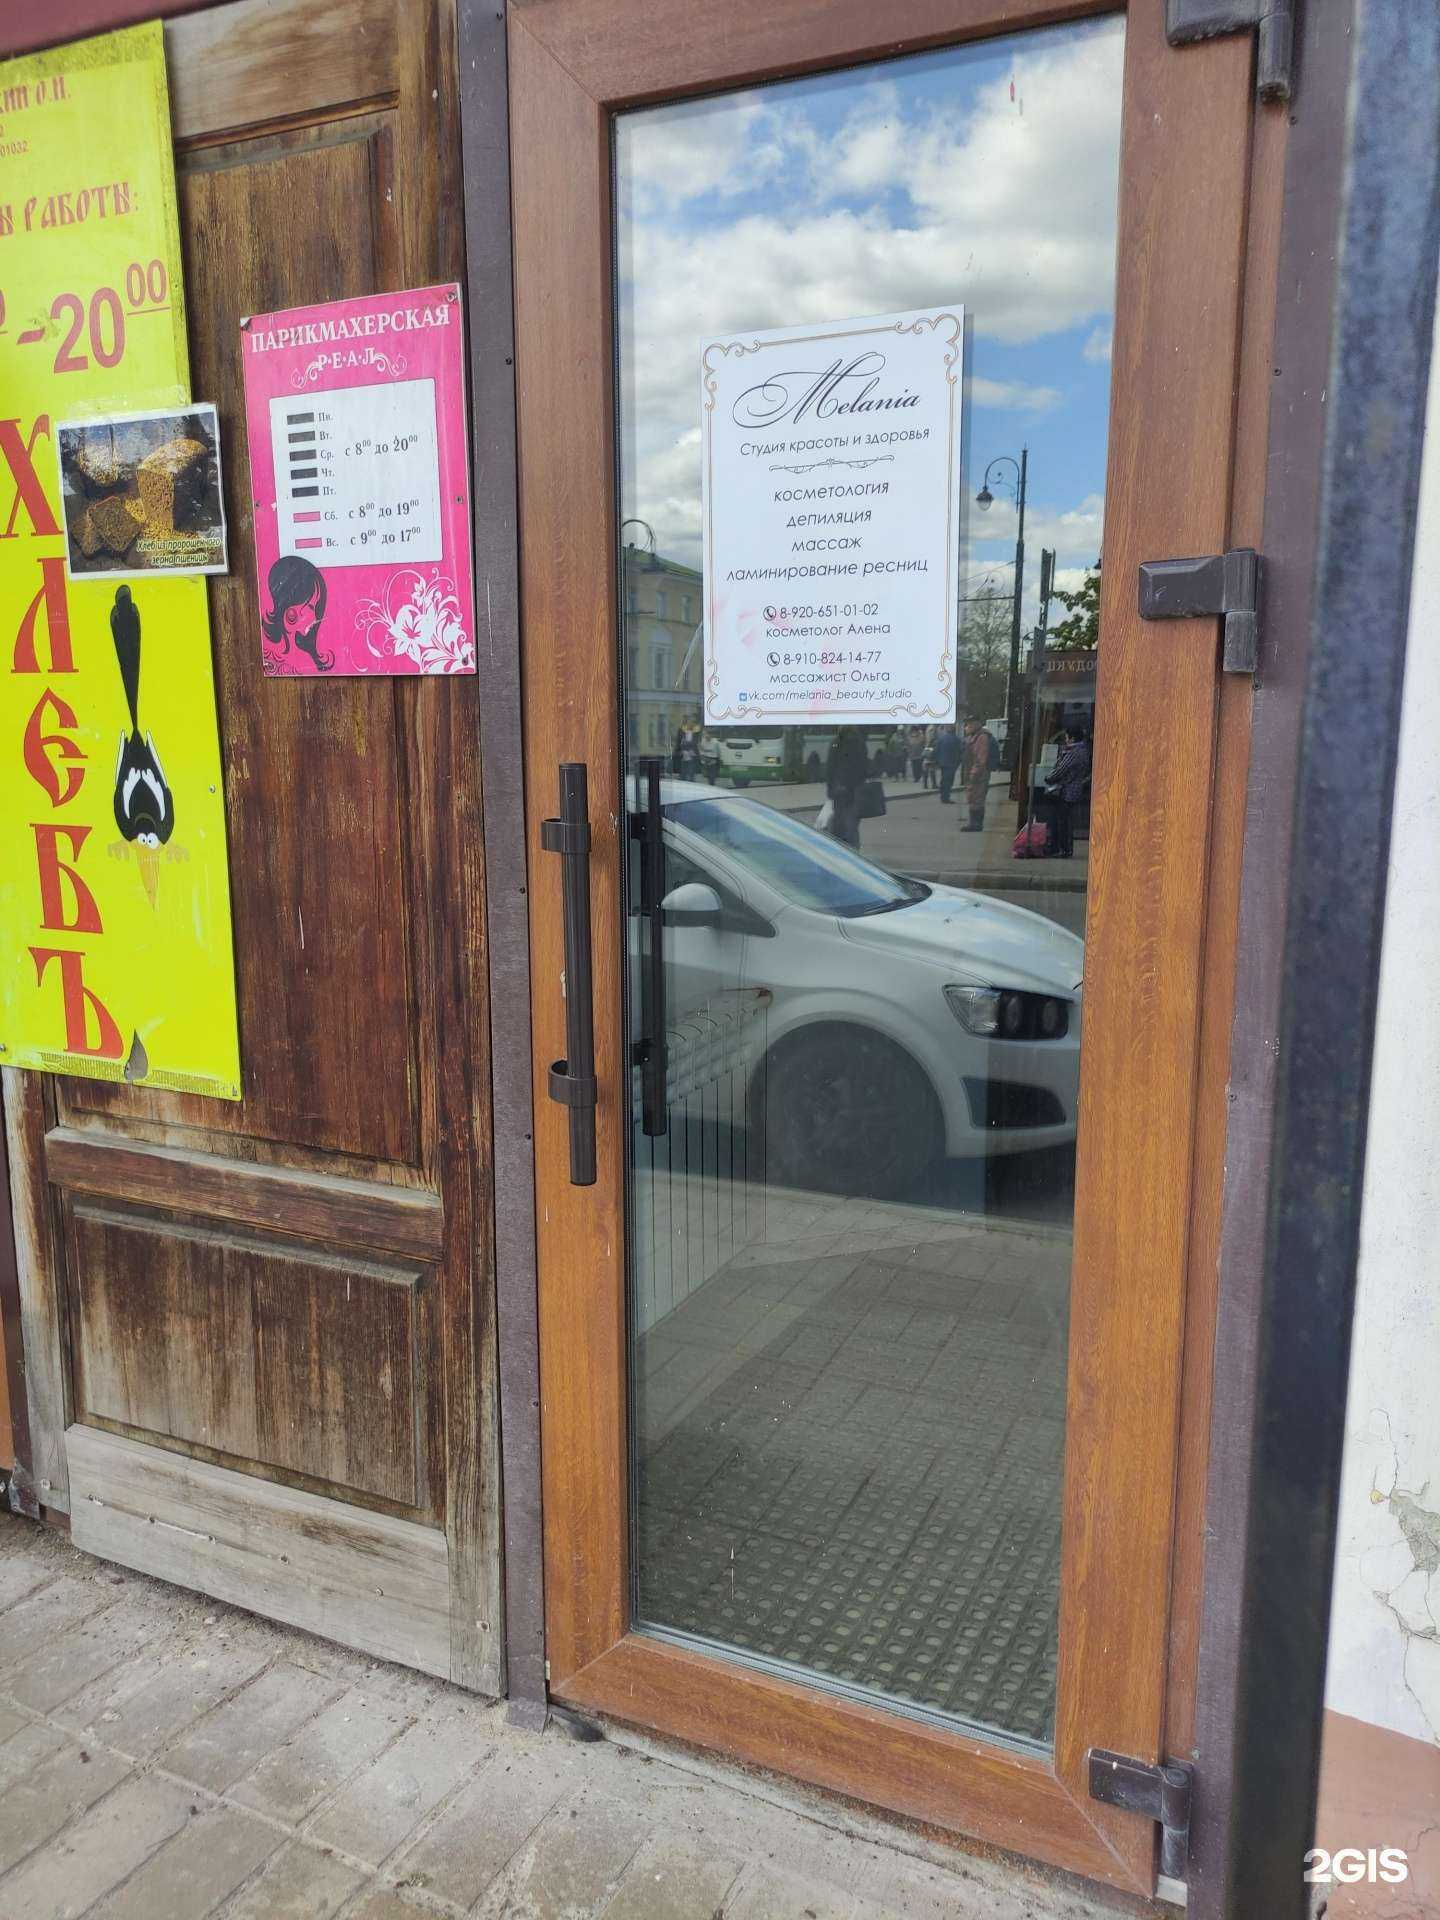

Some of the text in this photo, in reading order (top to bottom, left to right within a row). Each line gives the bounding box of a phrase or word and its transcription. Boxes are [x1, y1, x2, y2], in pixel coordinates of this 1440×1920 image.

[251, 304, 450, 353] ПАРИКМАХЕРСКАЯ
[732, 351, 921, 429] Melania
[319, 431, 332, 441] Вт.
[740, 428, 930, 457] Студия красоты и здоровья
[320, 450, 334, 461] Ср.
[374, 444, 389, 456] до
[321, 468, 335, 478] Чт.
[322, 486, 337, 496] Пт.
[774, 482, 889, 502] косметология
[324, 511, 338, 521] Сб.
[378, 507, 392, 518] до
[786, 509, 872, 528] депиляция
[326, 538, 339, 547] Вс.
[381, 534, 395, 544] до
[791, 536, 863, 552] массаж
[726, 559, 929, 581] ламинирование ресниц
[779, 603, 879, 619] 8-920-651-01-02
[766, 622, 891, 639] косметолог Алена
[783, 651, 882, 666] 8-910-824-14-77
[769, 670, 890, 684] массажист Ольга
[748, 688, 912, 701] vk.com/melania_beauty_studio
